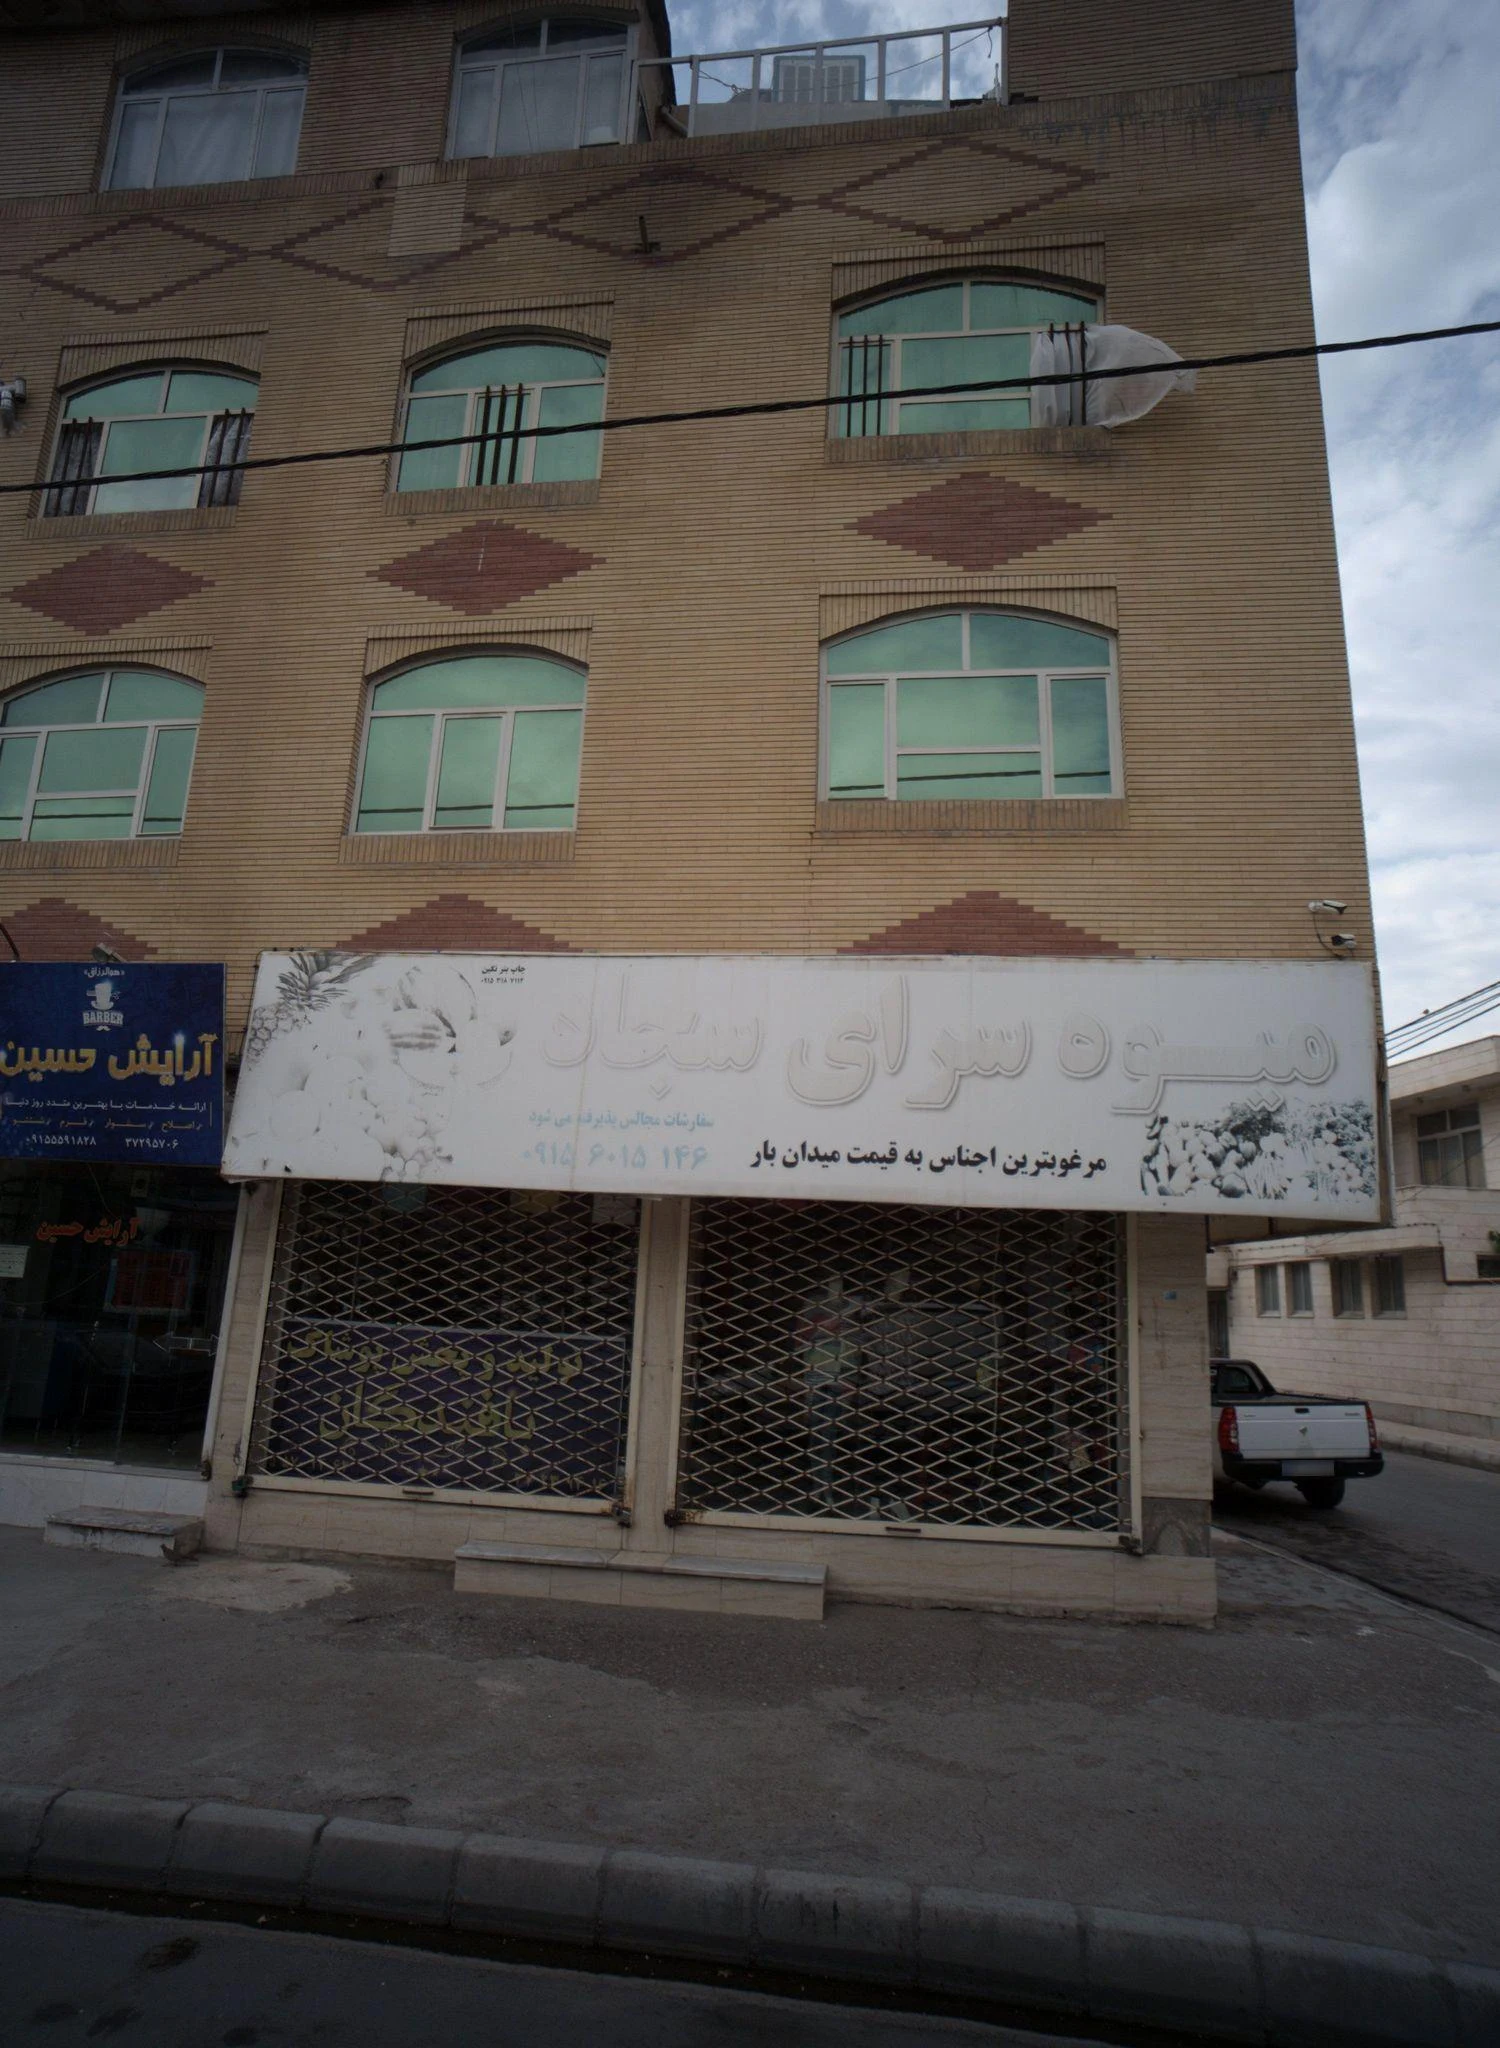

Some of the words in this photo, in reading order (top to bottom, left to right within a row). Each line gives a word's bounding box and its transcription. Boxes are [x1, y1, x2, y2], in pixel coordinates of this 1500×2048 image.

[83, 1010, 124, 1026] BARBER
[785, 974, 1032, 1109] سرای
[0, 1040, 97, 1082] حسین
[108, 1033, 218, 1086] آرایش
[1056, 1008, 1338, 1115] میوه
[31, 1098, 44, 1109] روز
[73, 1099, 108, 1112] بهترین
[110, 1099, 123, 1111] با
[126, 1100, 176, 1111] خدمات
[178, 1102, 207, 1113] ارائه
[528, 1108, 552, 1127] شود
[554, 1111, 572, 1127] می
[619, 1110, 661, 1130] مجالس
[520, 1141, 573, 1168] ۰۹۱۵
[588, 1142, 647, 1169] ۶۰۱۵
[661, 1144, 709, 1171] ۱۴۶
[750, 1139, 776, 1168] بار
[782, 1140, 841, 1169] میدان
[847, 1141, 899, 1171] قیمت
[904, 1148, 923, 1172] به
[929, 1145, 997, 1174] اجناس
[1002, 1149, 1107, 1179] مرغوبترین
[36, 1221, 84, 1244] حسین
[84, 1216, 142, 1247] آرایش
